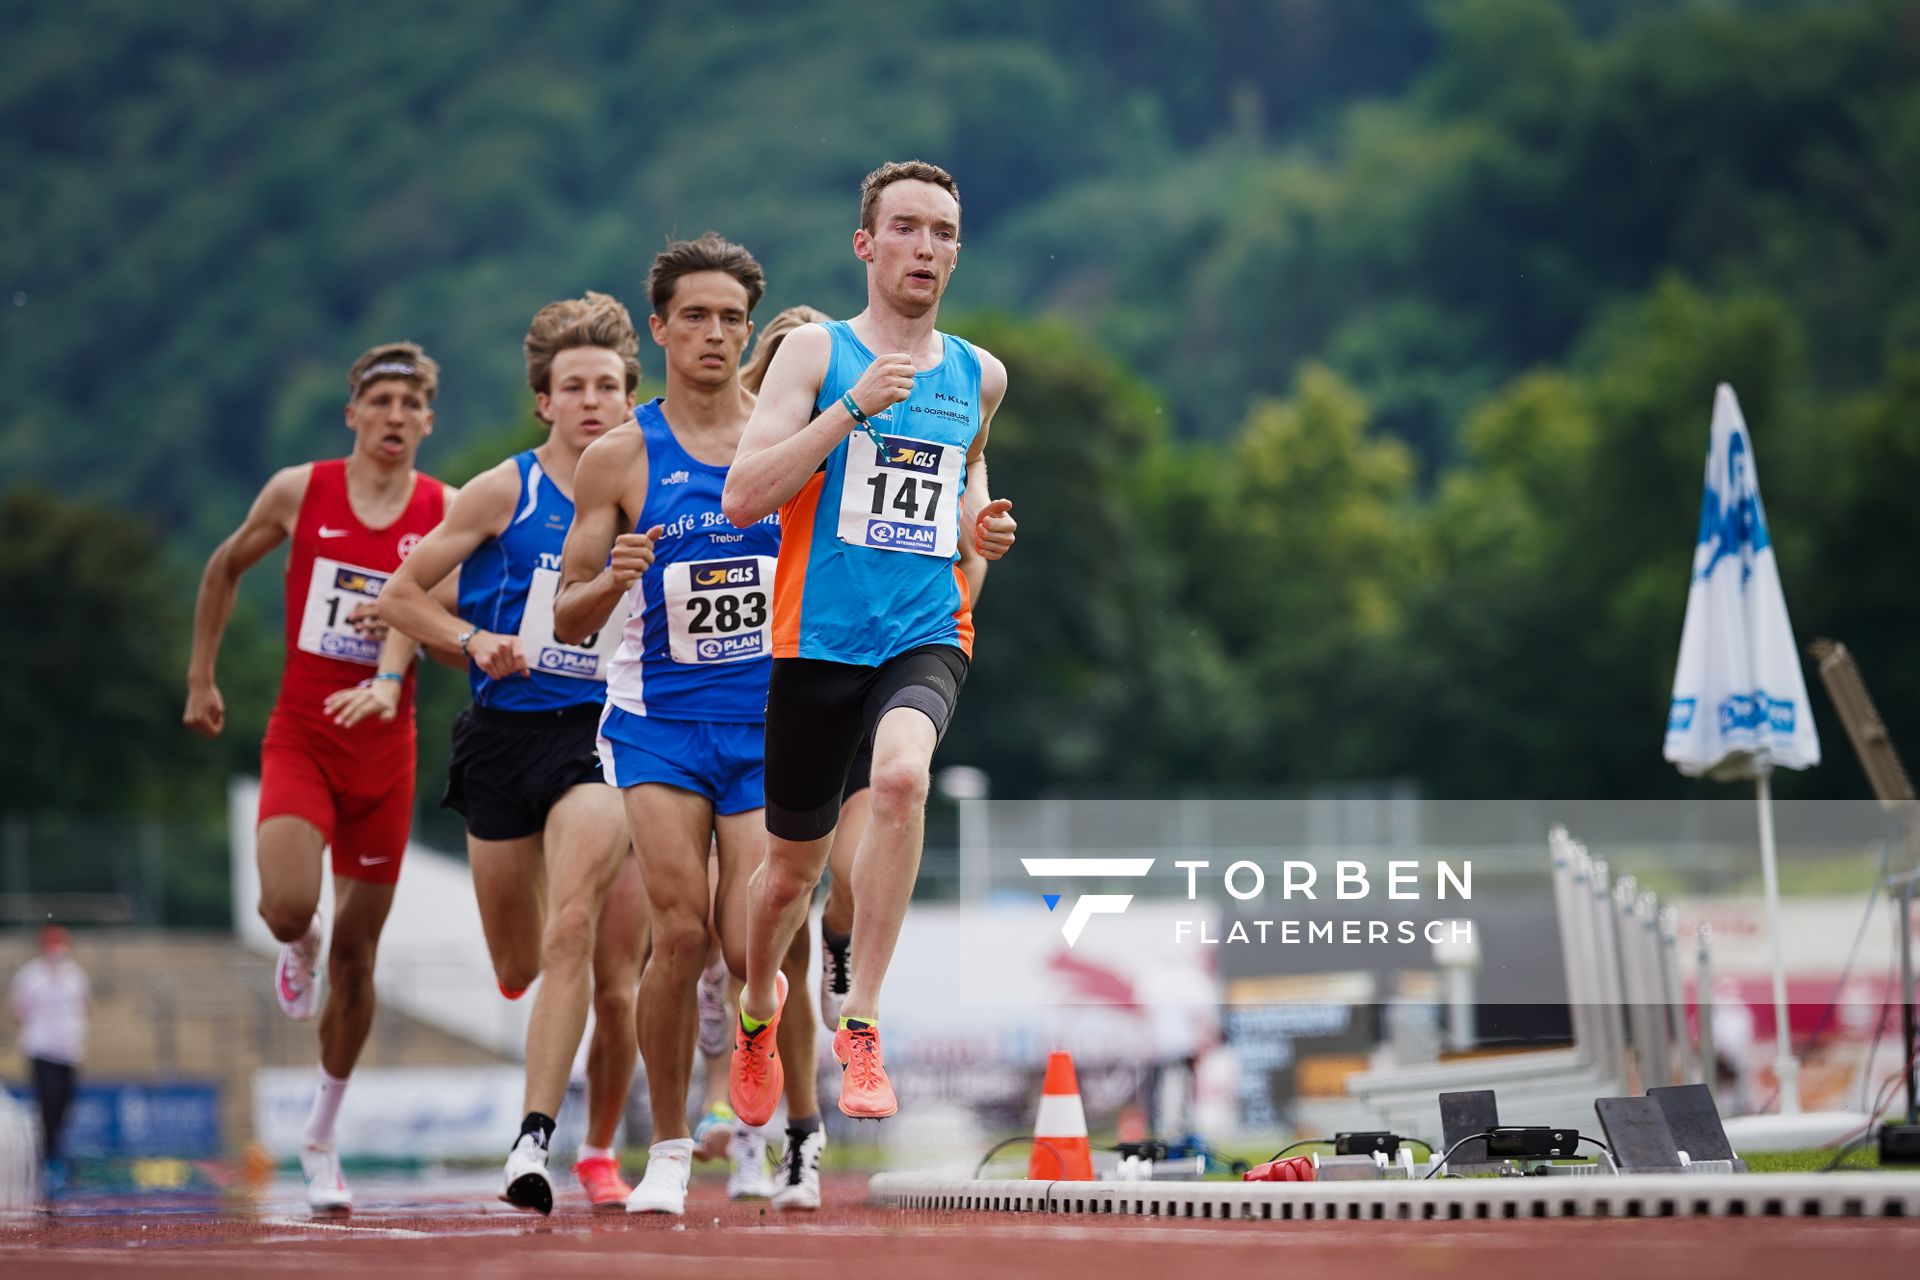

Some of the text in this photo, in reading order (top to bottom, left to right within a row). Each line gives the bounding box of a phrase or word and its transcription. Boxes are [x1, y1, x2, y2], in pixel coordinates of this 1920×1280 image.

[910, 405, 922, 413] LG
[912, 451, 937, 468] GLS
[867, 472, 943, 522] 147
[709, 533, 744, 543] Trebur
[896, 527, 934, 543] PLAN
[727, 566, 754, 583] GLS
[686, 591, 767, 634] 283
[724, 635, 760, 651] PLAN
[564, 653, 597, 669] PLAN
